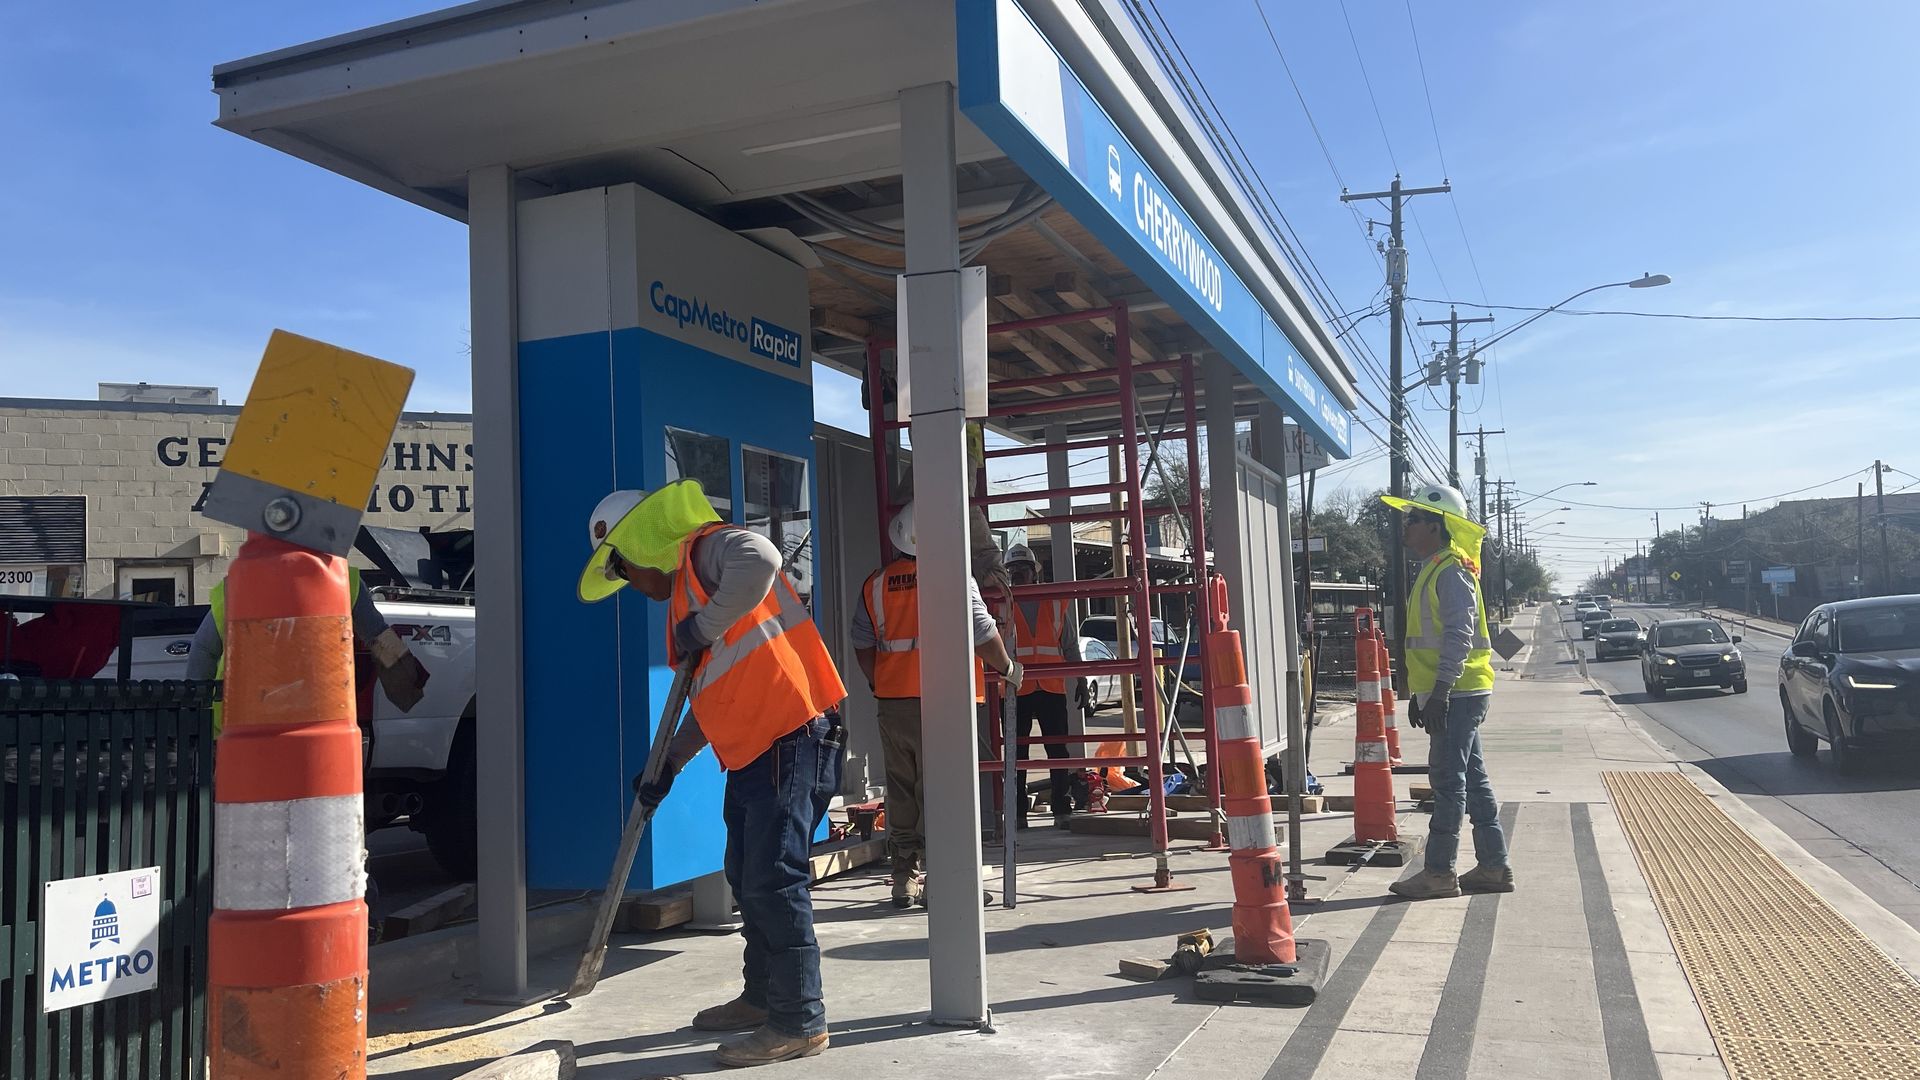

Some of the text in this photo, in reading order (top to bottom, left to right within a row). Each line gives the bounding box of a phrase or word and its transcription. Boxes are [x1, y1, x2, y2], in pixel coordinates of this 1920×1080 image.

[1134, 172, 1222, 312] CHERRYWOOD
[650, 280, 798, 361] CapMetro Rapid
[157, 436, 227, 467] GE
[0, 571, 33, 584] 2300
[390, 623, 451, 641] FX4
[50, 949, 154, 993] METRO
